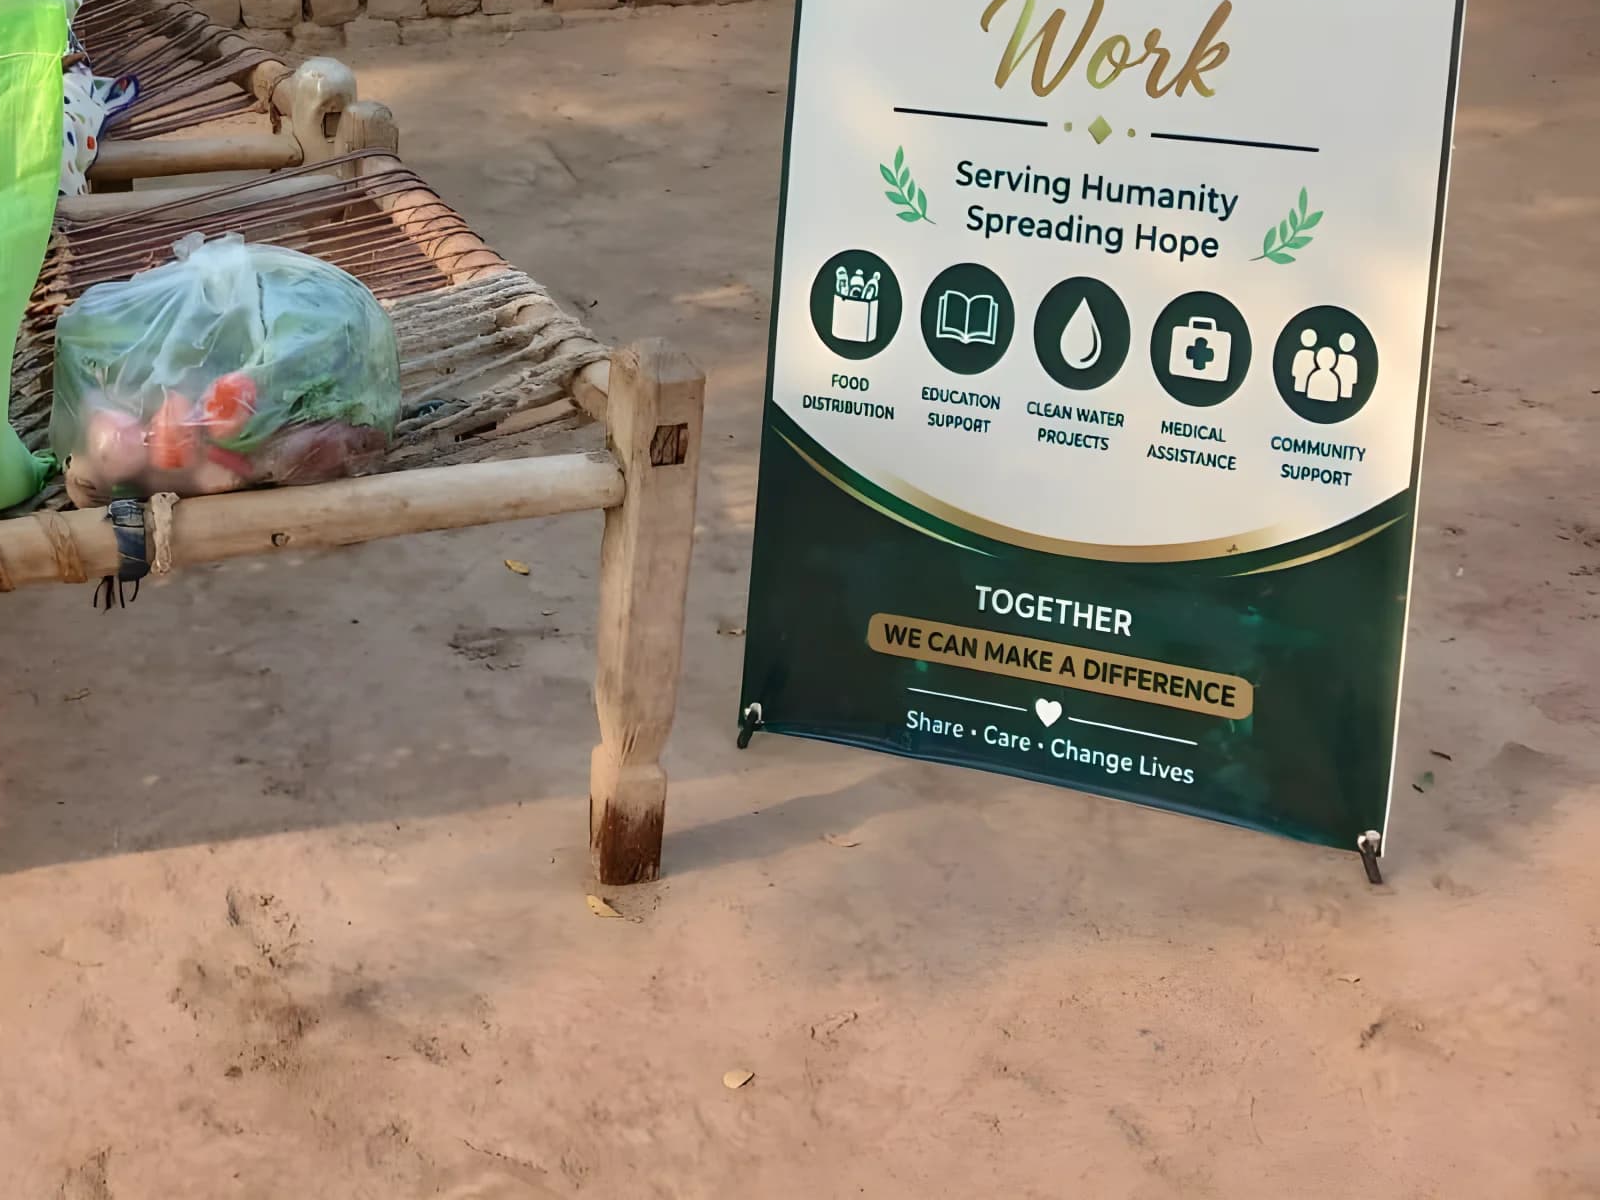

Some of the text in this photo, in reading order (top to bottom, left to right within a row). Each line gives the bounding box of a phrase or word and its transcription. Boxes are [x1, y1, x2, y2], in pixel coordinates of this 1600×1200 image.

[955, 160, 1239, 221] Serving Humanity
[966, 205, 1219, 262] Spreading Hope
[831, 374, 869, 392] FOOD
[802, 394, 895, 420] DISTRIBUTION
[921, 386, 1000, 410] EDUCATION
[927, 412, 991, 433] SUPPORT
[1026, 400, 1125, 427] CLEAN WATER
[1037, 427, 1109, 450] PROJECTS
[1160, 420, 1226, 443] MEDICAL
[1146, 444, 1237, 470] ASSISTANCE
[1270, 436, 1366, 462] COMMUNITY
[1280, 463, 1352, 487] SUPPORT
[975, 585, 1133, 637] TOGETHER
[884, 623, 1236, 707] WE CAN MAKE A DIFFERENCE
[906, 710, 1195, 784] Share Care Change Lives
